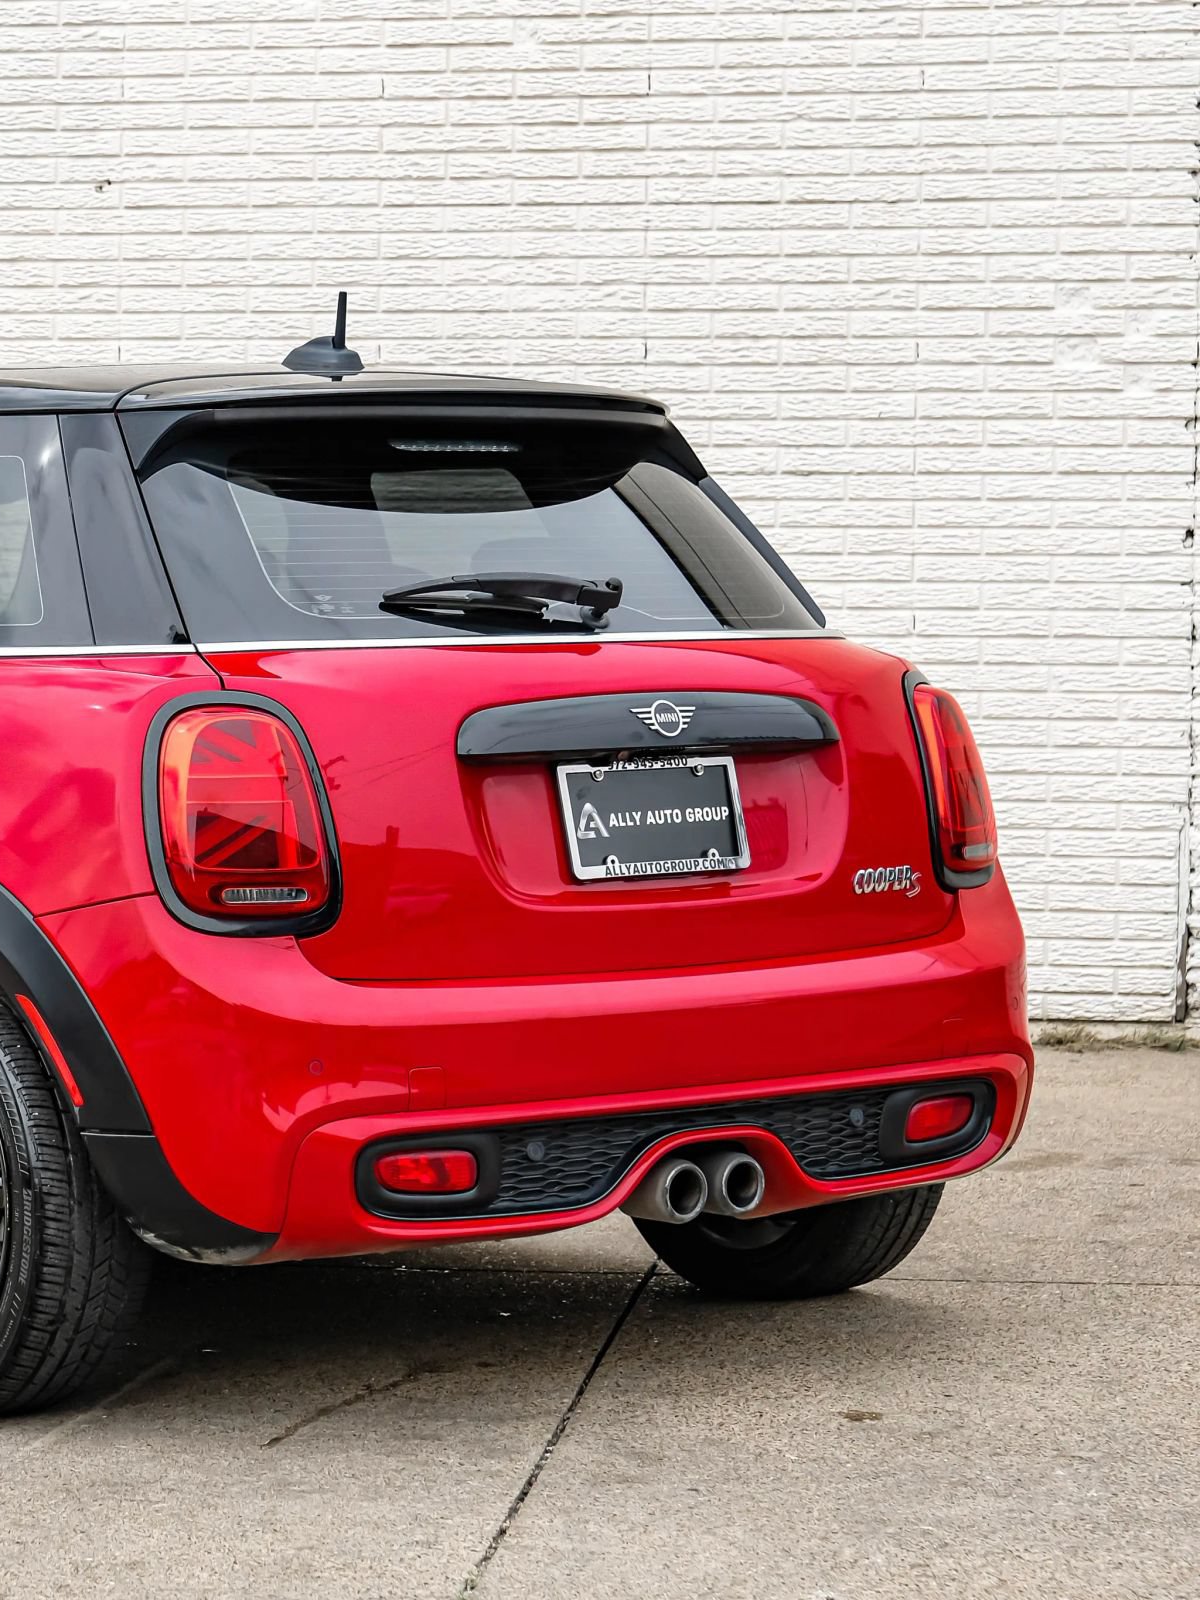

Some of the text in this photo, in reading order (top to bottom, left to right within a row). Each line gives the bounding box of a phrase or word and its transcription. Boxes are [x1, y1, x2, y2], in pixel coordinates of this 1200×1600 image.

[656, 712, 679, 723] MINI
[609, 806, 730, 828] ALLY AUTO GROUP
[605, 858, 725, 877] ALLYAUTOGROUP.COM
[854, 865, 911, 895] COOPER
[18, 1187, 33, 1286] BRIDGESTONE
